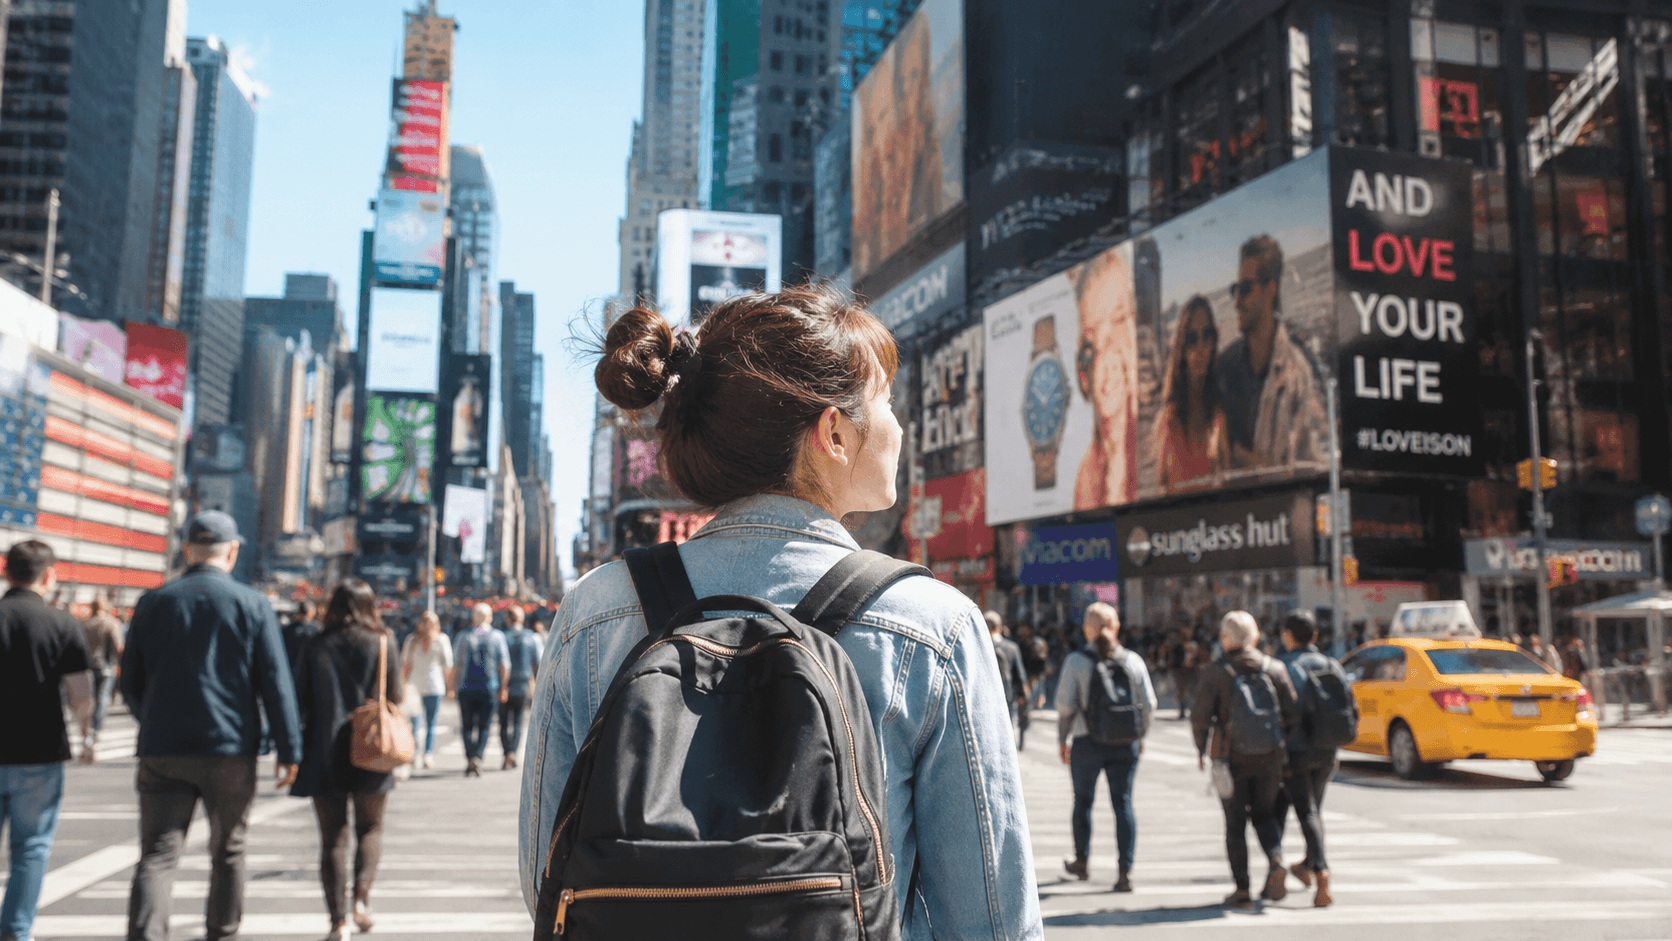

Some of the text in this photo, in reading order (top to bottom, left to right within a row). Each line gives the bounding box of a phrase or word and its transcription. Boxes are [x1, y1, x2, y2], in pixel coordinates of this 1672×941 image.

[1346, 168, 1434, 217] AND
[1348, 228, 1457, 282] LOVE
[1350, 290, 1465, 344] YOUR
[1353, 355, 1443, 404] LIFE
[1356, 427, 1472, 457] #LOVEISON
[1151, 511, 1291, 563] sunglass hut
